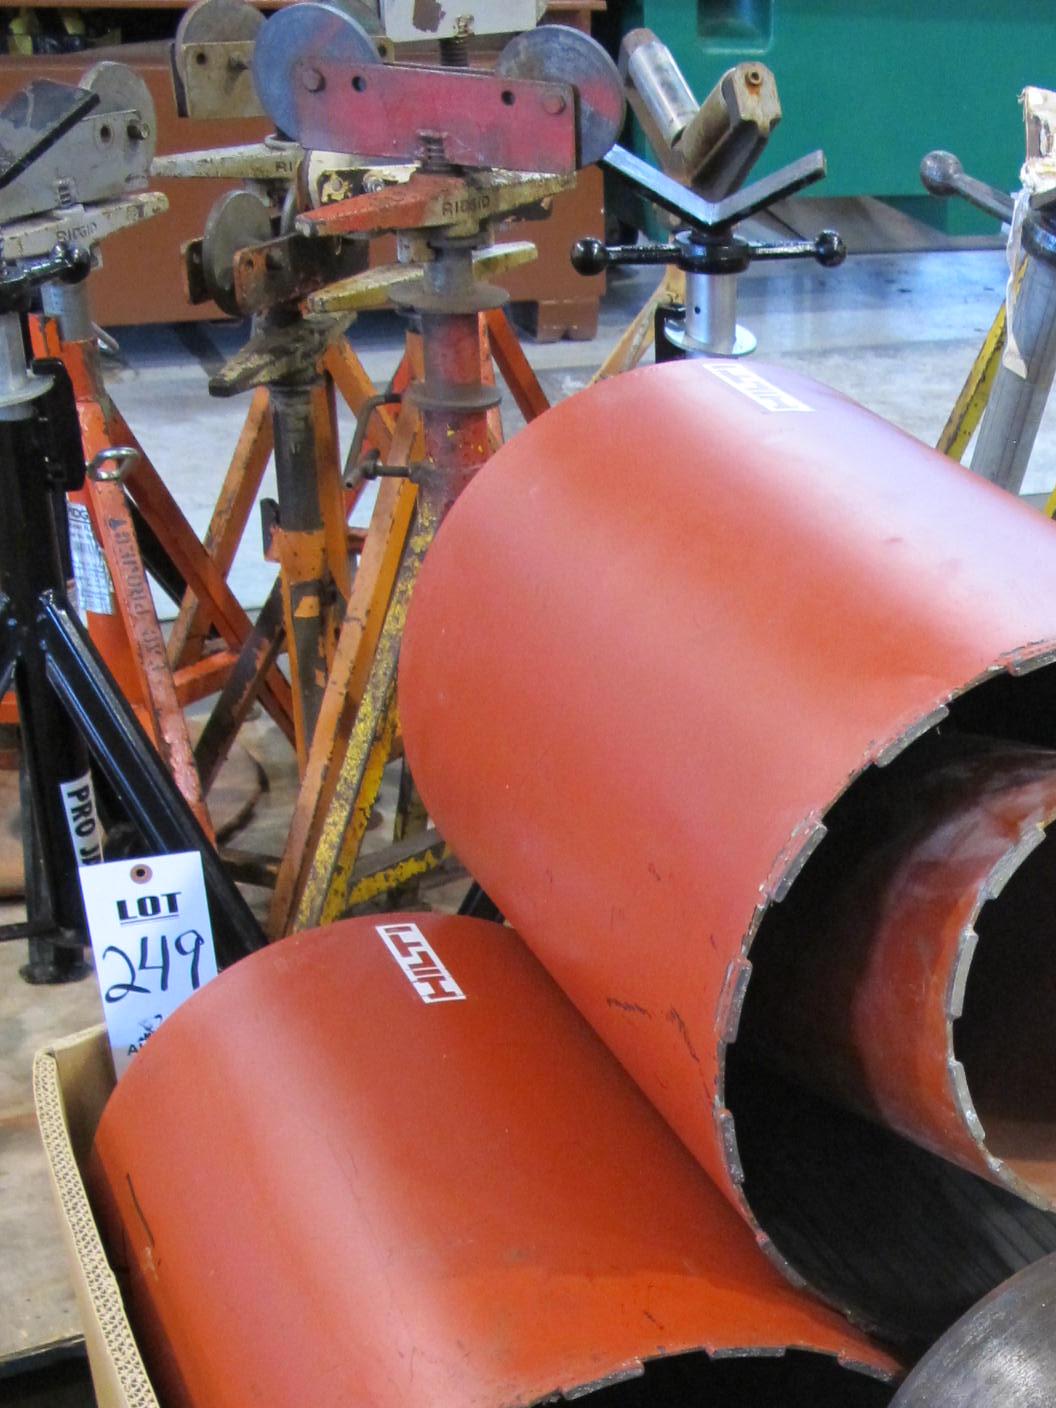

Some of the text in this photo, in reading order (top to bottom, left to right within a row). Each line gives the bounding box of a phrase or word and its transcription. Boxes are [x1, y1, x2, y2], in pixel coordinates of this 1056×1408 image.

[67, 784, 97, 837] PRO
[116, 891, 182, 921] LOT
[102, 929, 205, 1004] 249
